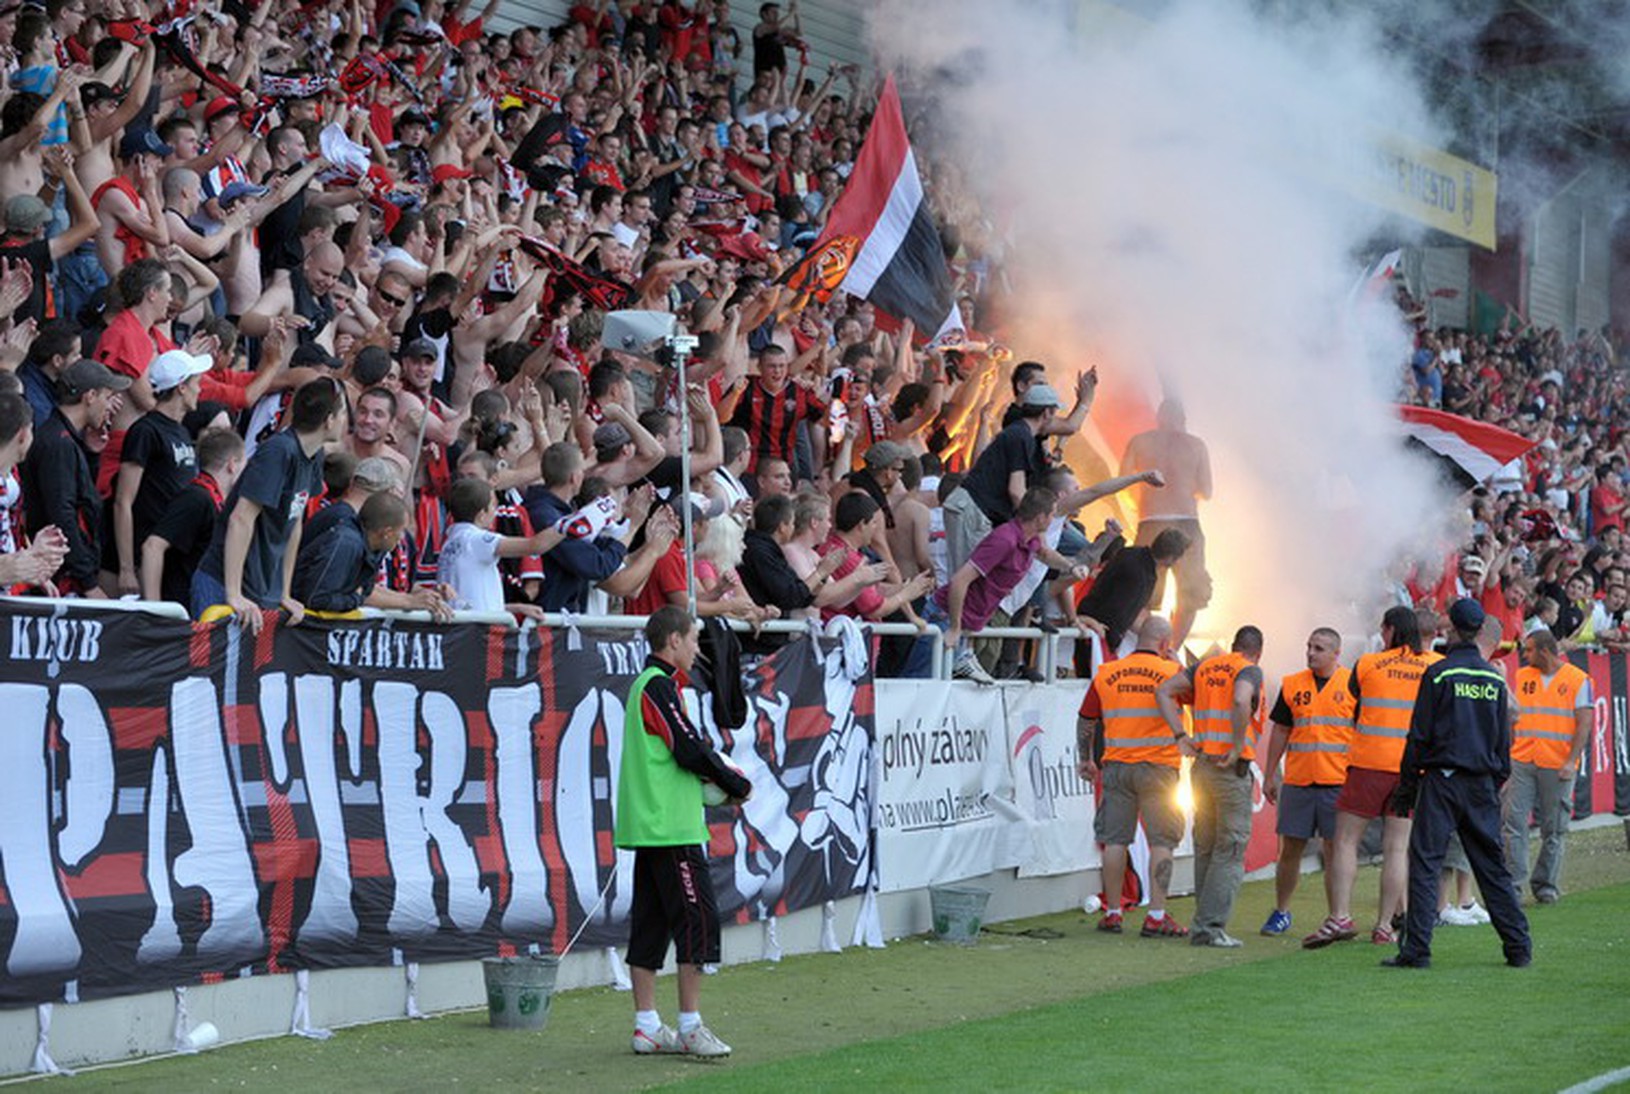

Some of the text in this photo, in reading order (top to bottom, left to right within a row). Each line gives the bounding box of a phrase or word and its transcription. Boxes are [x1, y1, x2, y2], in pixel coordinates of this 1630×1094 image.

[10, 615, 652, 675] KLUB SPARTAK TRN
[1387, 669, 1421, 680] STEWAR
[1293, 691, 1312, 706] 49
[1454, 682, 1499, 701] HASIČI
[883, 715, 989, 780] plný zábav
